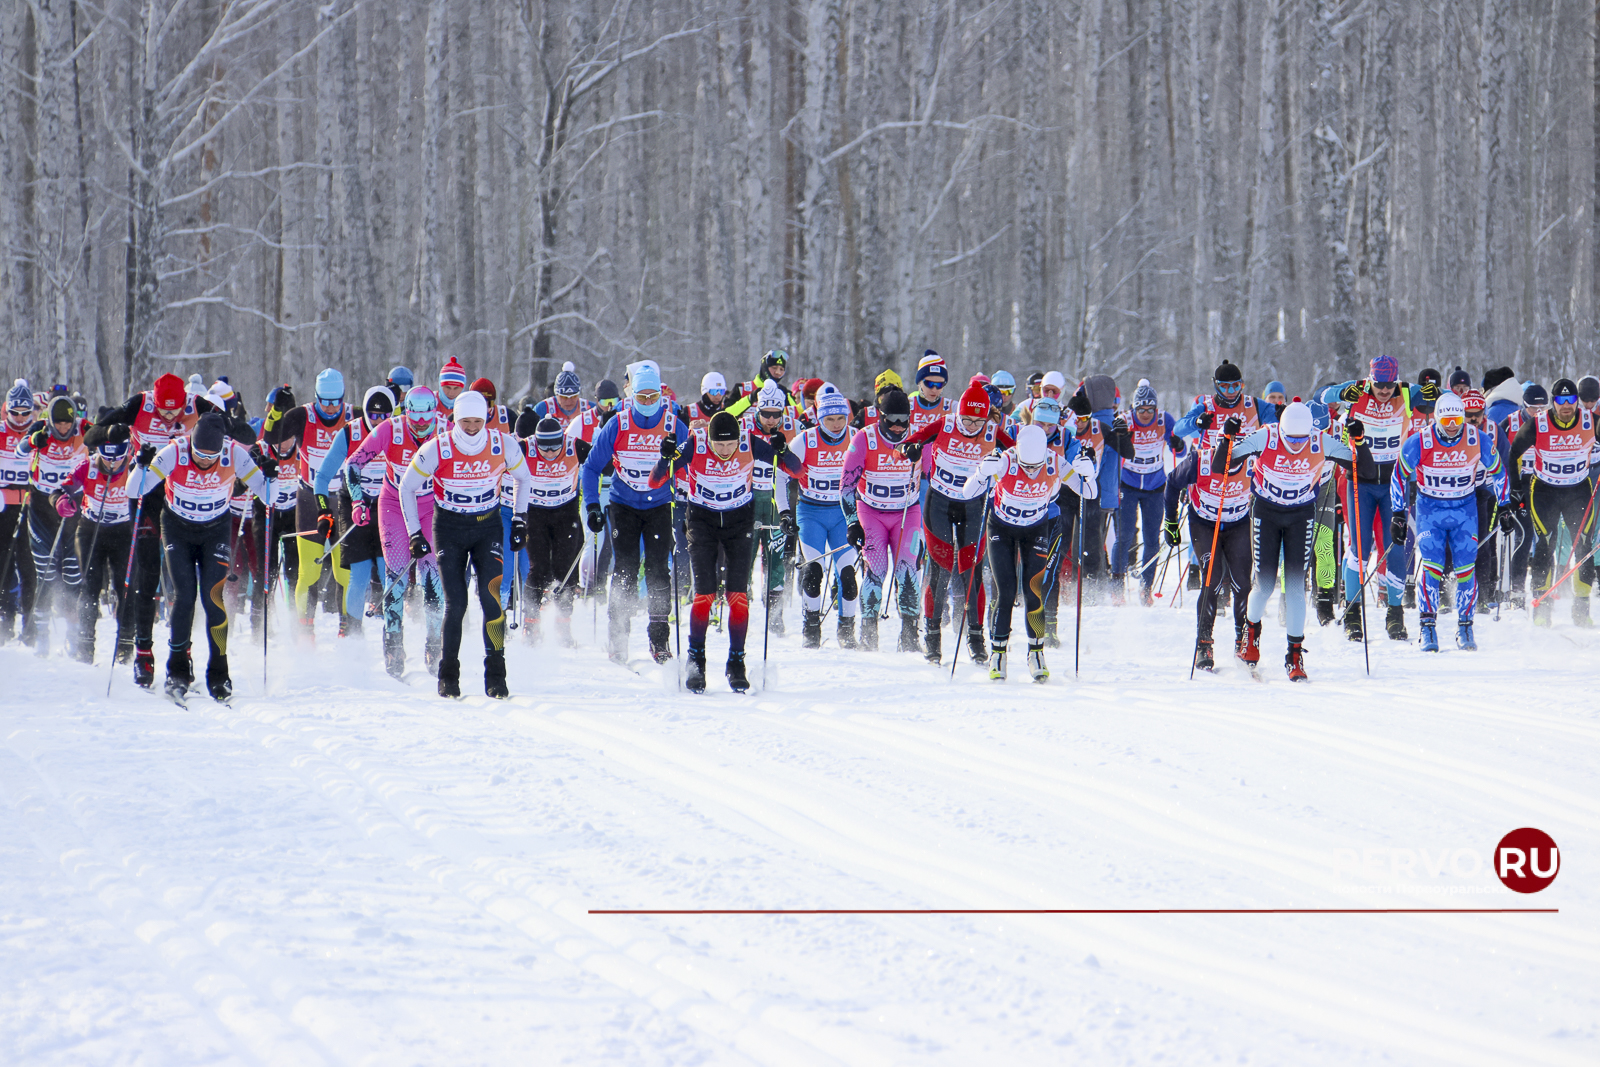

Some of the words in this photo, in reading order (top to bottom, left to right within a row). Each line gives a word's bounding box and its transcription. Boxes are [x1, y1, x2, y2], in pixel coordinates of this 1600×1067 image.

[948, 438, 983, 455] EA26
[1364, 434, 1400, 450] 056
[1549, 434, 1582, 447] EA26
[1274, 454, 1311, 470] EA26
[1433, 450, 1468, 463] EA26
[453, 459, 491, 474] EA26
[705, 457, 741, 473] EA26
[810, 477, 840, 491] 105
[936, 465, 968, 488] 102
[1425, 474, 1471, 488] 1149
[696, 483, 747, 502] 1208
[1013, 479, 1049, 494] EA26
[1253, 516, 1262, 573] BIVIUM
